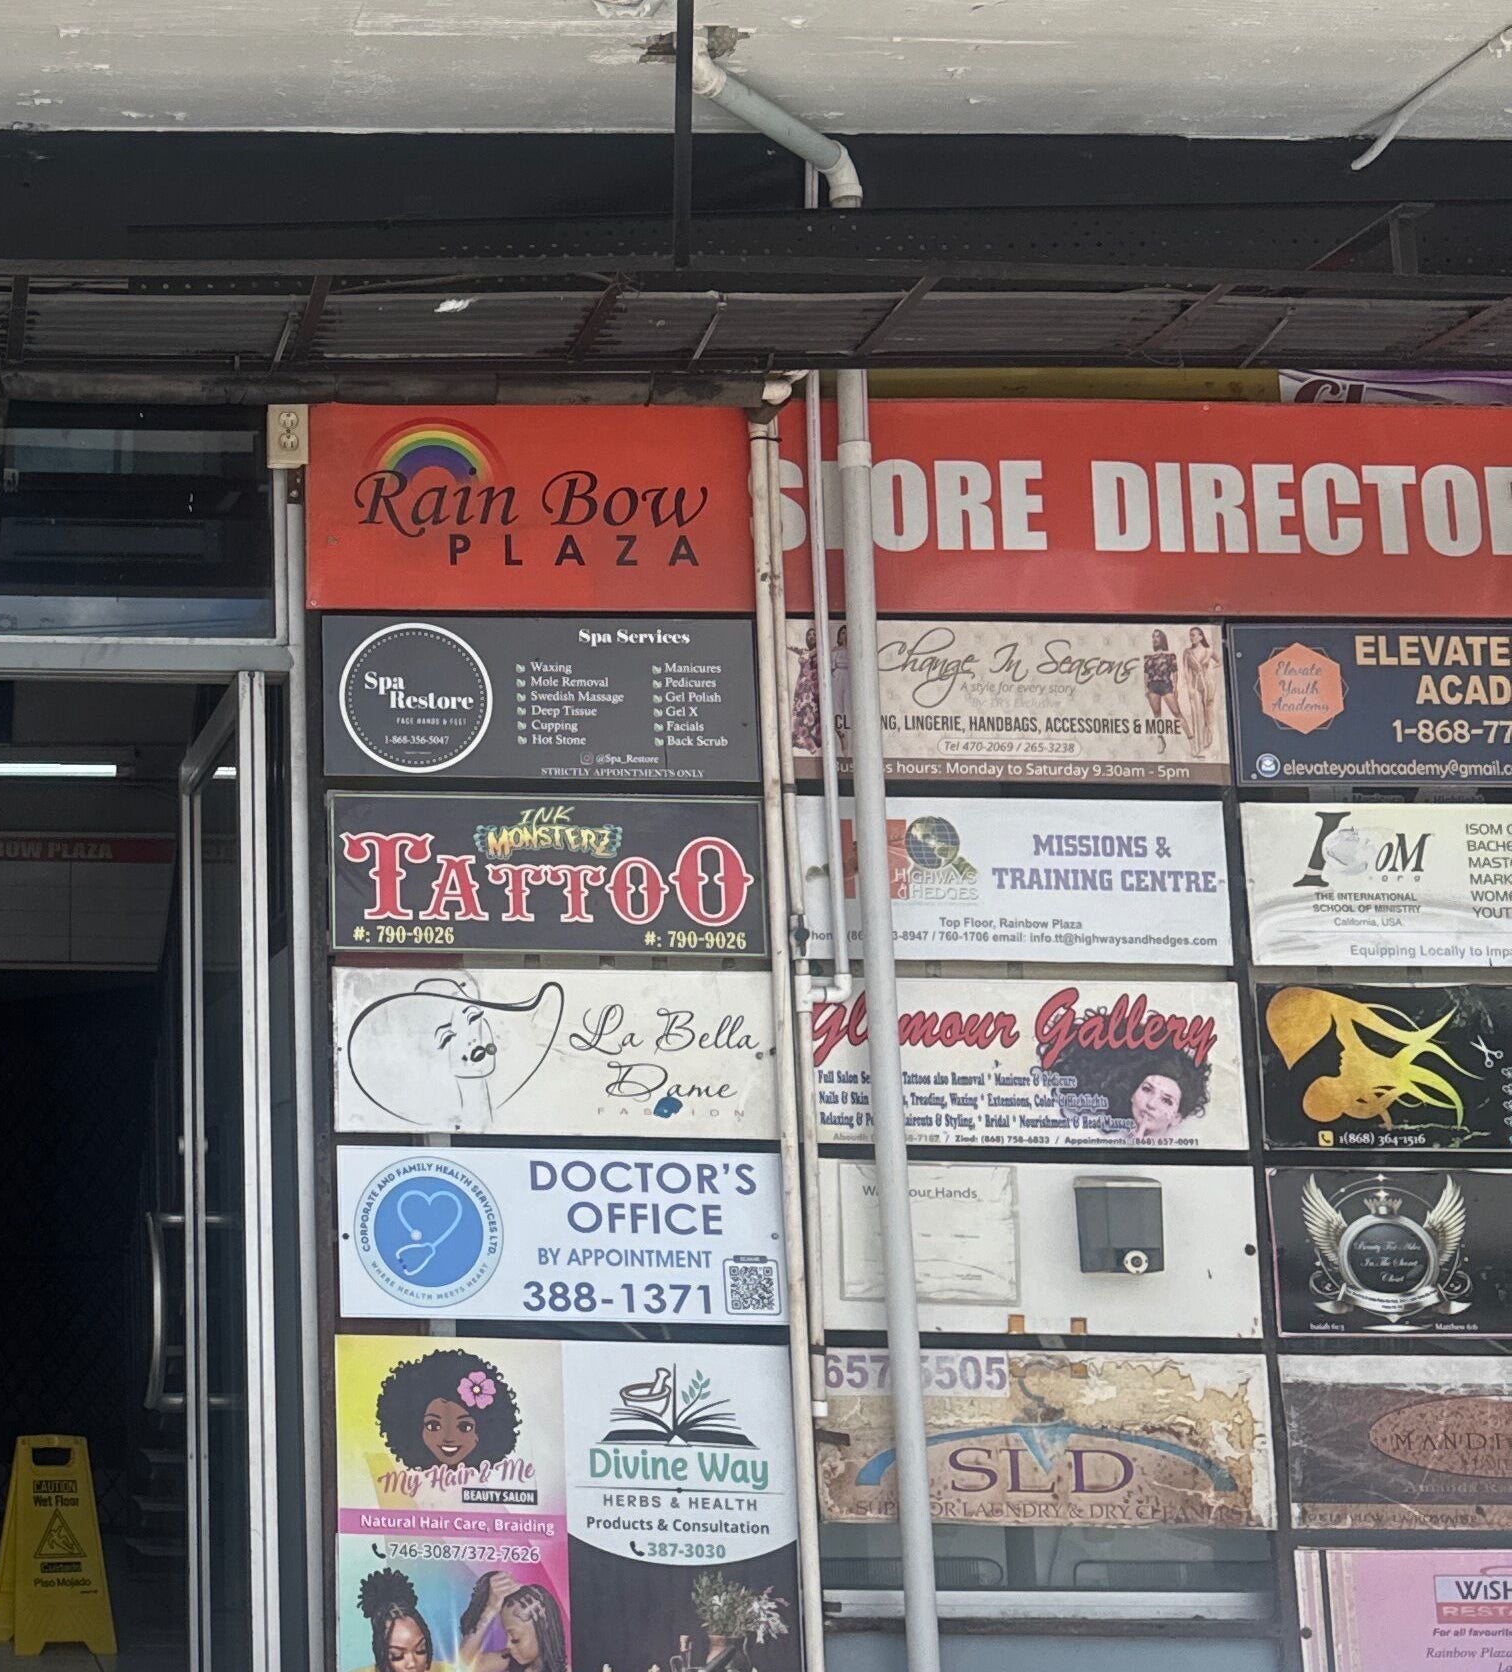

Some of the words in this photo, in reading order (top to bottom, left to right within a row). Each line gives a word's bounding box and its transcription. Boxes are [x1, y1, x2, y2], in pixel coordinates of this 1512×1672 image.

[354, 469, 520, 537] Rain
[542, 470, 708, 528] Bow
[449, 534, 700, 566] PLAZA
[579, 629, 612, 646] Spa
[617, 630, 690, 644] Services
[1354, 635, 1512, 667] ELEVATE
[530, 662, 572, 674] Waxing
[665, 663, 721, 673] Manicures
[877, 627, 979, 708] Change
[990, 643, 1029, 681] In
[1037, 639, 1140, 684] Seasons
[1275, 661, 1322, 676] Elevate
[364, 671, 405, 695] Spa
[531, 677, 559, 686] Mole
[562, 677, 608, 687] Removal
[665, 677, 716, 687] Pedicures
[970, 682, 995, 694] style
[1018, 684, 1045, 695] every
[1049, 684, 1076, 695] story
[1279, 680, 1319, 697] Youth
[1416, 675, 1512, 705] ACAD
[390, 691, 474, 709] Restore
[531, 691, 574, 701] Swedish
[578, 691, 624, 704] Massage
[665, 692, 685, 702] Gel
[689, 692, 721, 702] Polish
[1272, 697, 1328, 713] Academy
[531, 705, 560, 718] Deep
[563, 706, 597, 716] Tissue
[666, 706, 686, 716] Gel
[532, 720, 578, 732] Cupping
[666, 721, 704, 731] Facials
[905, 715, 966, 733] LINGERIE,
[969, 716, 1041, 734] HANDBAGS,
[1045, 717, 1130, 734] ACCESSORIES
[1145, 718, 1181, 735] MORE
[532, 734, 553, 744] Hot
[556, 735, 586, 745] Stone
[667, 735, 693, 746] Back
[696, 736, 728, 746] Scrub
[944, 741, 960, 751] Tel
[963, 741, 1014, 752] 470-2069
[1024, 742, 1075, 753] 265-3238
[596, 755, 659, 765] @Spa_Restore
[541, 768, 589, 776] STRICTLY
[594, 769, 676, 778] APPOINTMENTS
[676, 769, 705, 778] ONLY
[893, 762, 942, 775] hours:
[947, 763, 1003, 777] Monday
[1008, 765, 1022, 775] to
[1026, 763, 1089, 778] Saturday
[1093, 765, 1144, 777] 9.30am
[1158, 765, 1190, 781] 5pm
[520, 805, 575, 823] INK
[1466, 824, 1502, 835] ISOM
[487, 823, 611, 857] MONSTERZ
[1032, 834, 1148, 858] MISSIONS
[48, 842, 112, 860] PLAZA
[894, 869, 977, 885] HIGHWAYS
[992, 867, 1112, 891] TRAINING
[910, 886, 979, 900] HEDGES
[1316, 893, 1334, 901] THE
[1338, 893, 1416, 901] INTERNATIONAL
[1313, 904, 1355, 913] SCHOOL
[1375, 905, 1421, 913] MINISTRY
[939, 918, 960, 929] Top
[964, 917, 996, 930] Floor,
[999, 918, 1050, 929] Rainbow
[1052, 918, 1082, 930] Plaza
[1334, 918, 1379, 927] California,
[1382, 918, 1402, 926] USA
[377, 925, 454, 944] 790-9026
[668, 931, 746, 949] 790-9026
[938, 931, 989, 942] 760-1706
[992, 931, 1026, 943] email:
[1351, 945, 1416, 958] Equipping
[1421, 946, 1465, 958] Locally
[1470, 946, 1482, 956] to
[569, 1004, 643, 1055] La
[656, 1007, 759, 1051] Bella
[1035, 987, 1216, 1069] Gallery
[605, 1061, 737, 1102] Dame
[818, 1070, 834, 1084] Full
[837, 1071, 859, 1085] Salon
[902, 1071, 931, 1085] Tattoos
[933, 1072, 949, 1085] also
[951, 1072, 985, 1086] Removal
[995, 1073, 1030, 1086] Manicure
[850, 1092, 870, 1105] Skin
[949, 1093, 978, 1109] Waxing
[1034, 1094, 1055, 1107] Color
[820, 1112, 854, 1128] Relaxing
[985, 1115, 1010, 1128] Bridal
[1019, 1115, 1070, 1129] Nourishment
[529, 1160, 756, 1195] DOCTOR'S
[936, 1187, 978, 1199] Hands
[360, 1190, 379, 1252] CORPORATE
[396, 1163, 433, 1177] FAMILY
[436, 1164, 472, 1187] HEALTH
[471, 1185, 498, 1233] SERVICES
[568, 1201, 723, 1235] OFFICE
[538, 1248, 560, 1266] BY
[568, 1248, 712, 1269] APPOINTMENT
[523, 1280, 712, 1315] 388-1371
[589, 1448, 688, 1481] Divine
[697, 1452, 769, 1490] Way
[948, 1447, 1136, 1495] SLD
[34, 1480, 76, 1493] CAUTION
[378, 1468, 421, 1498] My
[424, 1461, 475, 1491] Hair
[494, 1458, 535, 1482] Me
[34, 1495, 52, 1507] Wet
[55, 1495, 79, 1507] Floor
[463, 1489, 499, 1503] BEAUTY
[503, 1491, 535, 1504] SALON
[603, 1493, 661, 1508] HERBS
[688, 1497, 758, 1511] HEALTH
[961, 1501, 1064, 1519] LAUNDRY
[1090, 1502, 1128, 1520] DRY
[361, 1515, 416, 1530] Natural
[420, 1516, 449, 1530] Hair
[452, 1517, 491, 1533] Care,
[493, 1518, 555, 1536] Braiding
[586, 1516, 654, 1533] Products
[672, 1518, 770, 1535] Consultation
[388, 1542, 540, 1562] 746-3087/372-7626
[647, 1541, 726, 1559] 387-3030
[1433, 1628, 1450, 1636] For
[1454, 1628, 1466, 1636] all
[1426, 1647, 1477, 1658] Rainbow
